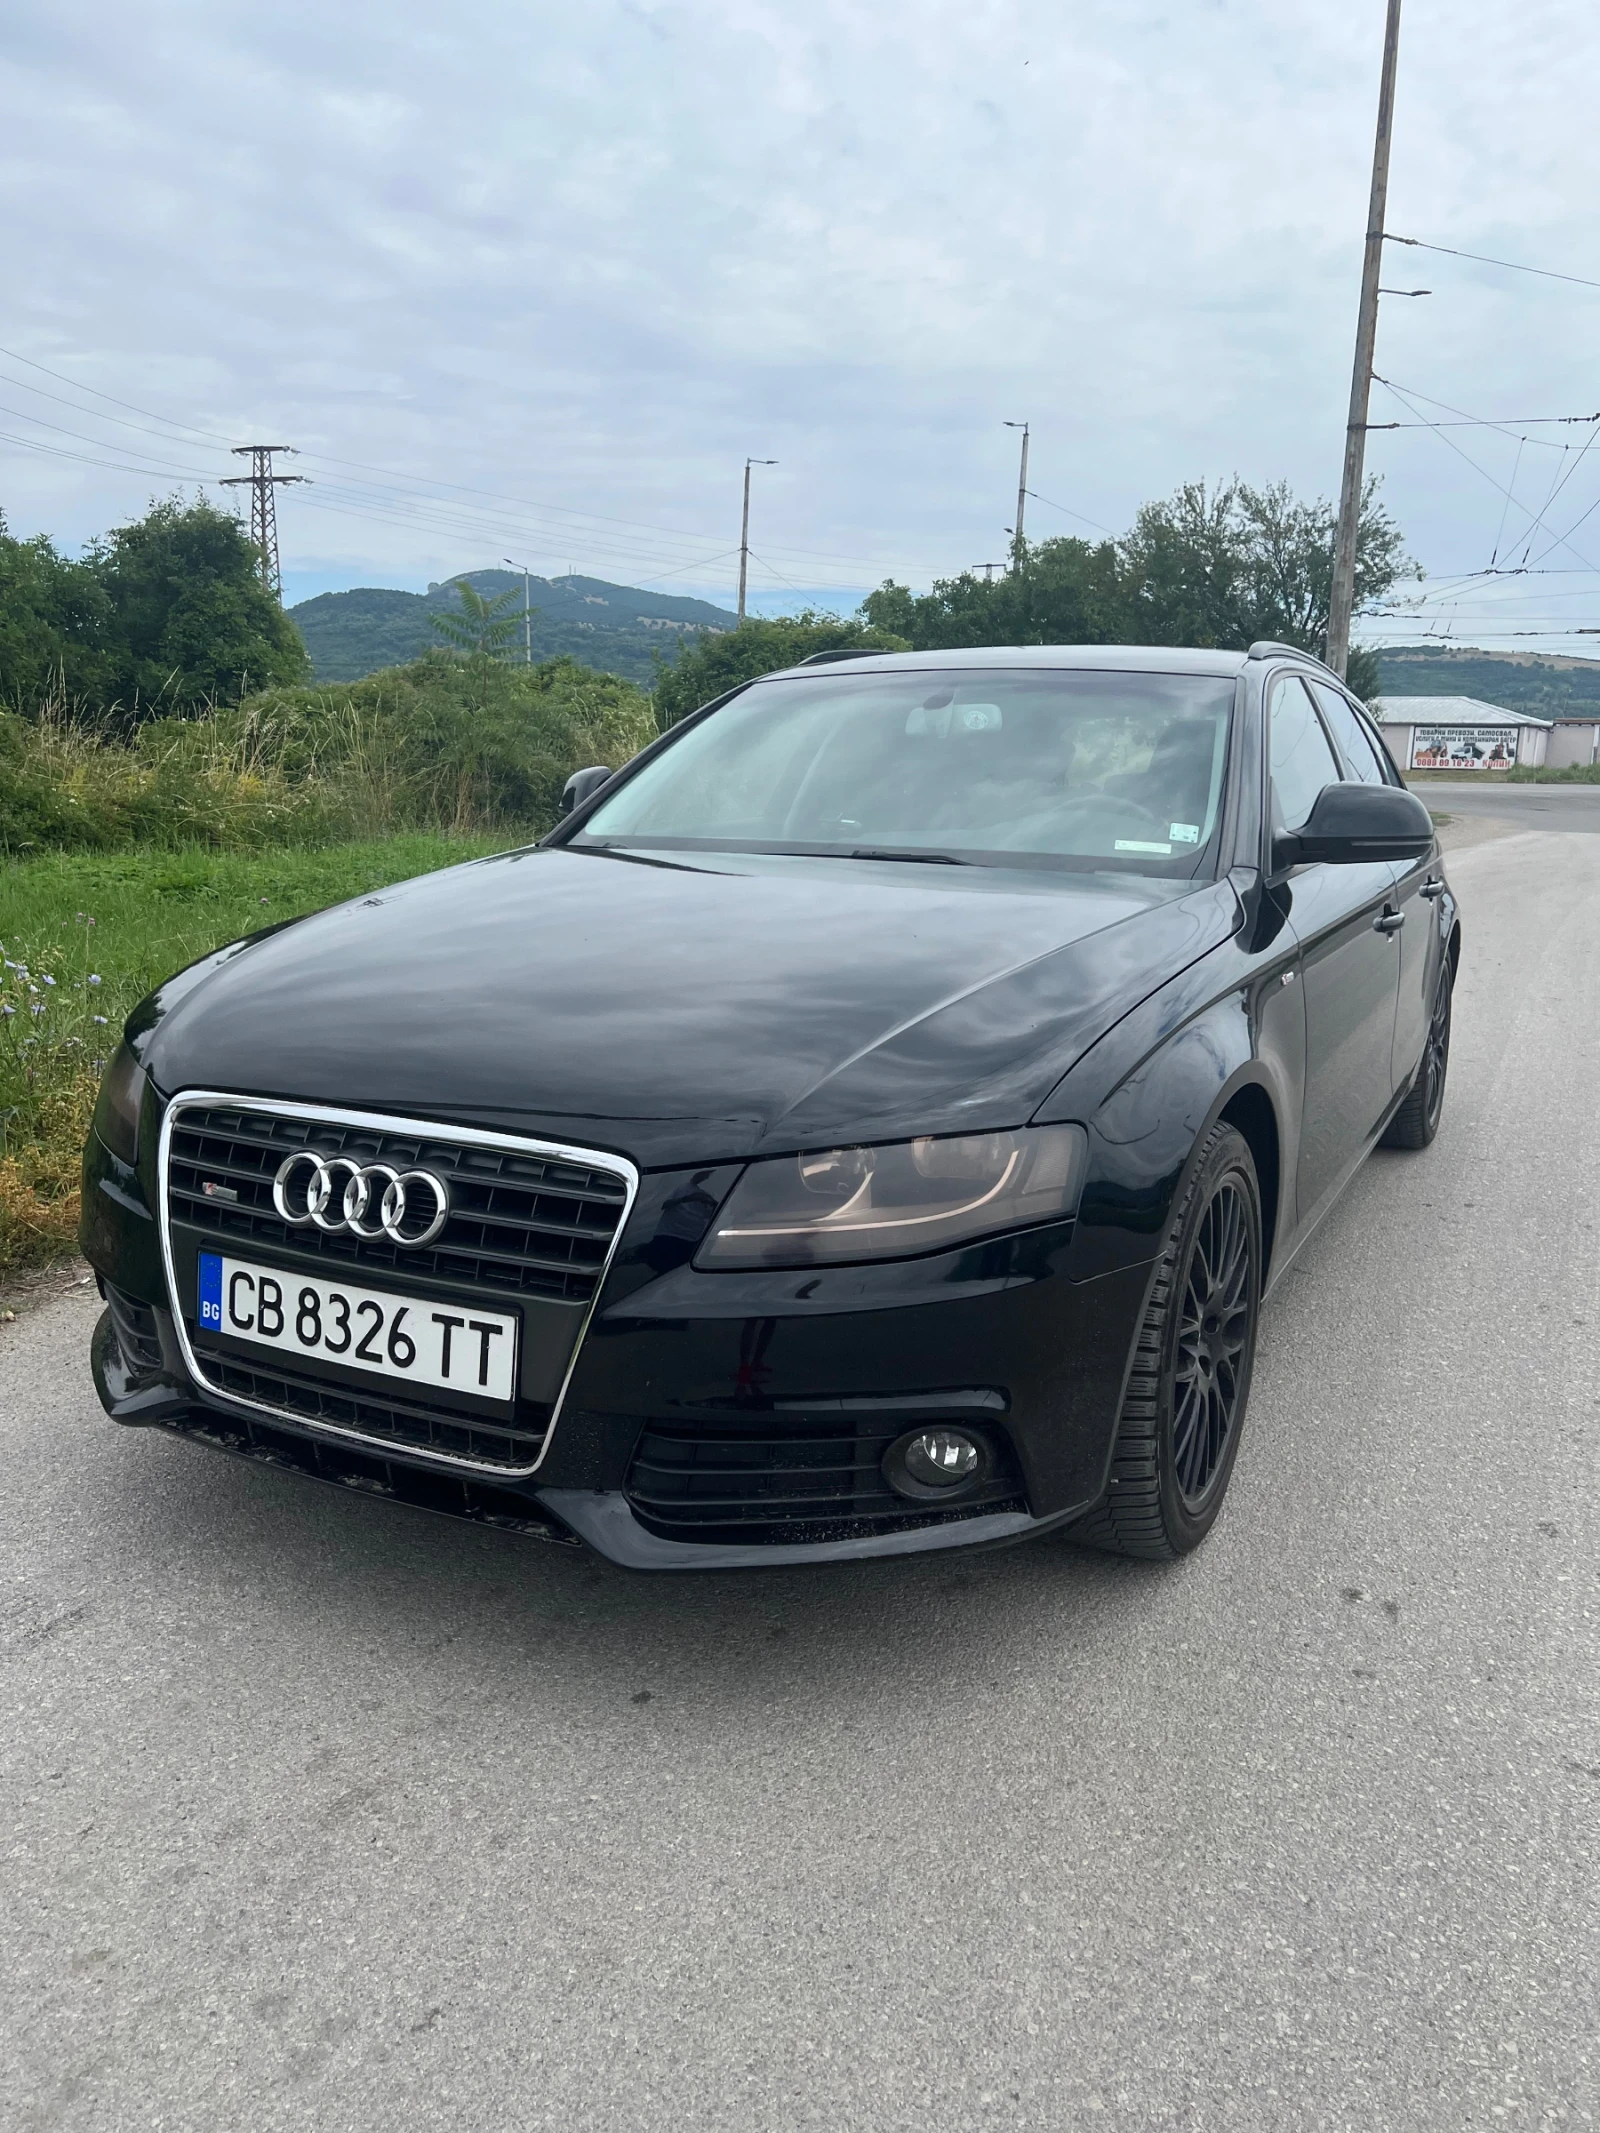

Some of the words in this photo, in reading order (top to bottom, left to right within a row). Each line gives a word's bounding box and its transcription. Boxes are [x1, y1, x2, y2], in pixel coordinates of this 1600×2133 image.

[1464, 759, 1475, 767] 23
[202, 1300, 219, 1320] BG
[228, 1270, 285, 1337] CB
[295, 1286, 416, 1369] 8326
[431, 1312, 504, 1386] TT
